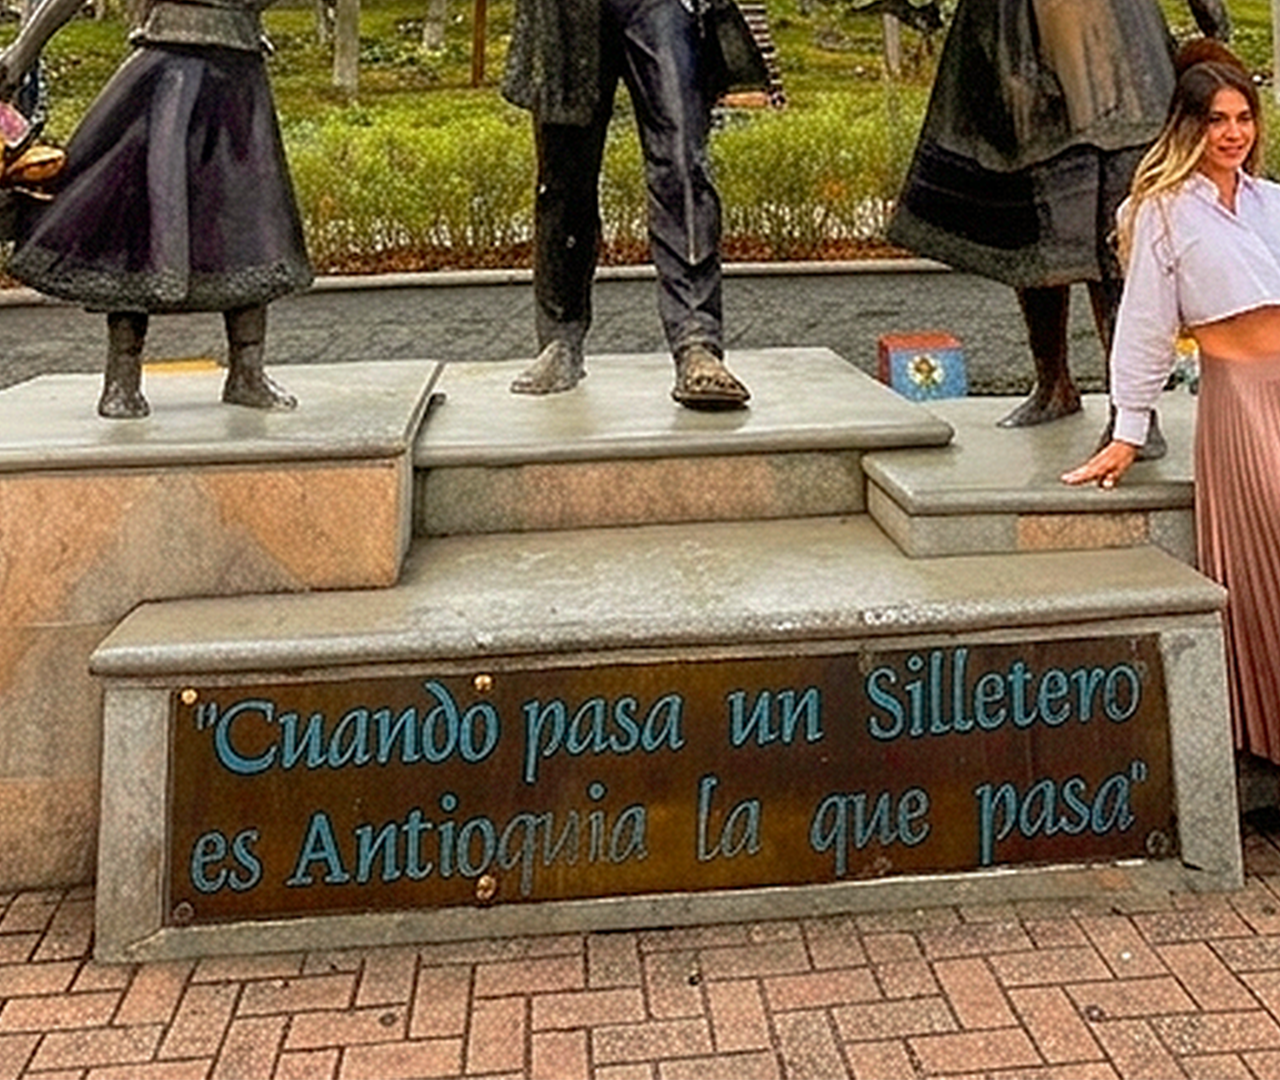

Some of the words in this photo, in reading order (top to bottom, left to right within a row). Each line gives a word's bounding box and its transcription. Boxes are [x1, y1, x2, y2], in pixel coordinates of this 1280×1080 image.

[196, 679, 500, 776] "Cuando
[523, 693, 685, 783] pasa
[728, 686, 823, 747] un
[866, 648, 1141, 740] Silletero
[190, 827, 263, 894] es
[286, 781, 649, 896] Antioquia
[696, 775, 762, 862] la
[810, 786, 930, 877] que
[976, 759, 1148, 866] pasa"
